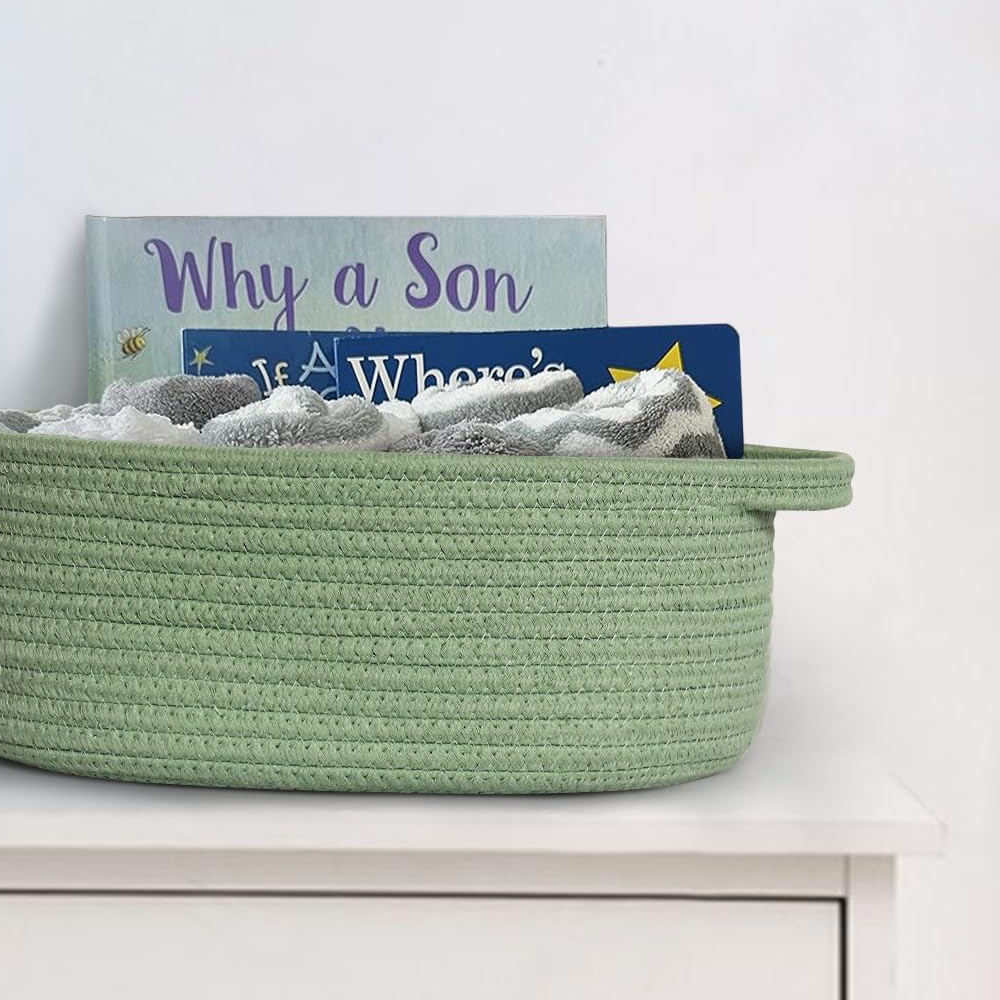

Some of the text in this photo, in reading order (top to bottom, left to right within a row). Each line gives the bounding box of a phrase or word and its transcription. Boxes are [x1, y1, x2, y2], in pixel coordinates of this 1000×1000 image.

[144, 231, 533, 331] Why a Son
[347, 347, 565, 402] Where'
